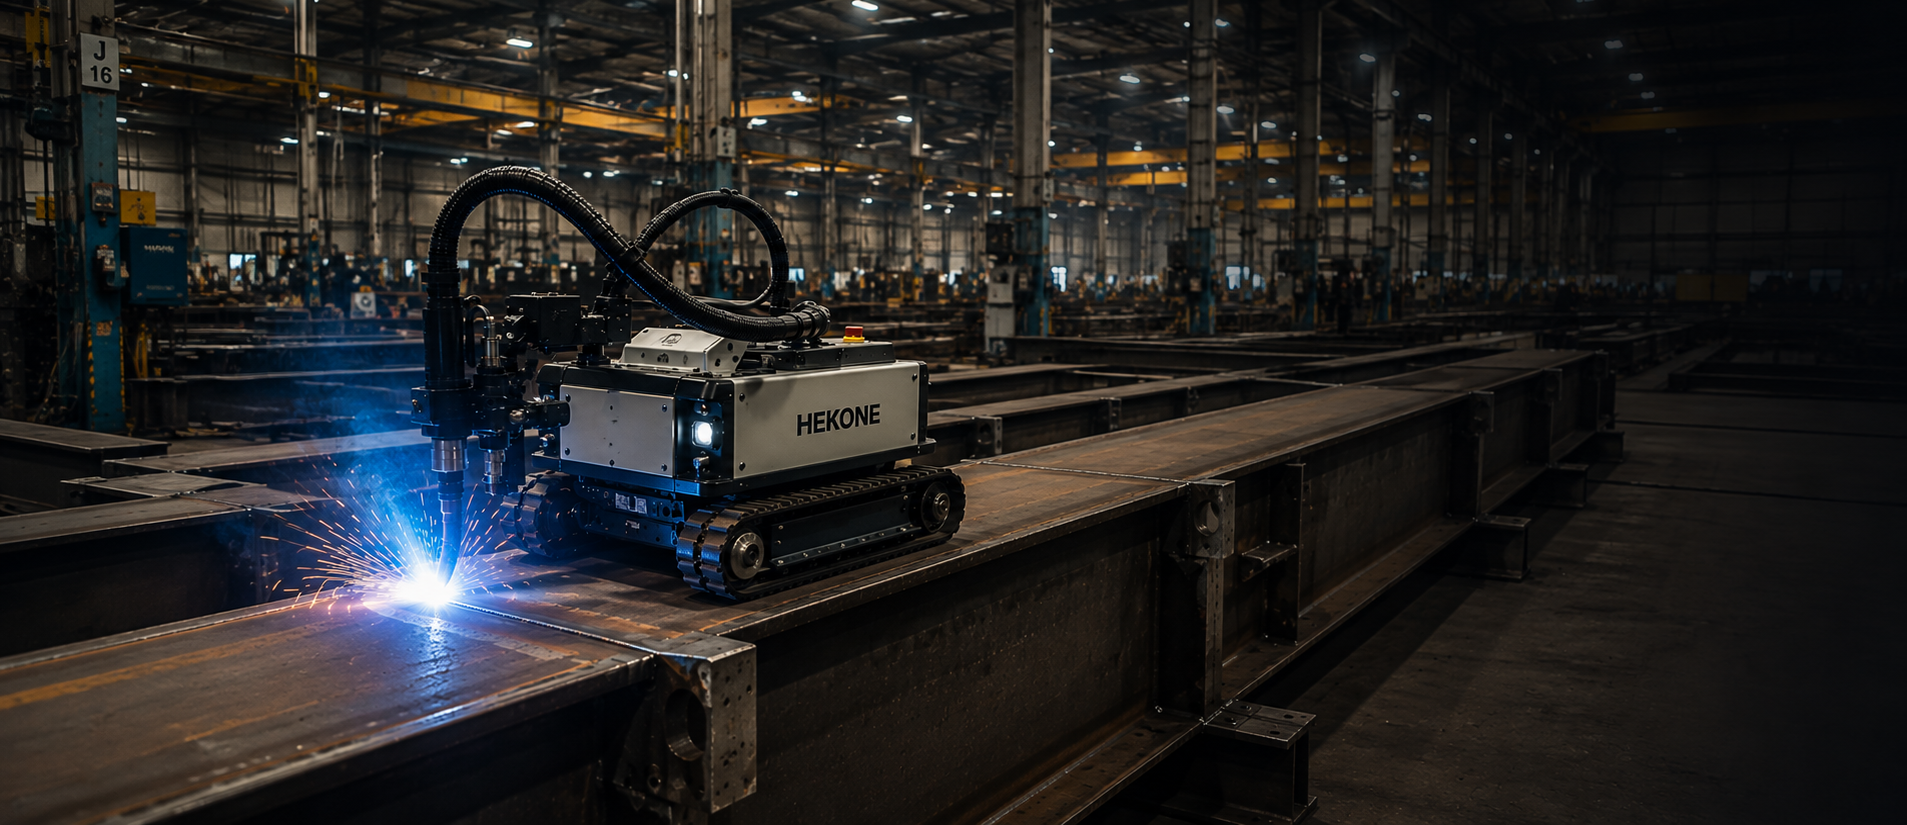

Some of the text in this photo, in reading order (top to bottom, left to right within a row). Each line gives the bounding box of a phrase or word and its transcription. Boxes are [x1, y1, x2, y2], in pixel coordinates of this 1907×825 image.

[94, 40, 105, 61] J
[90, 65, 112, 84] 16
[797, 403, 880, 436] HEKONE
